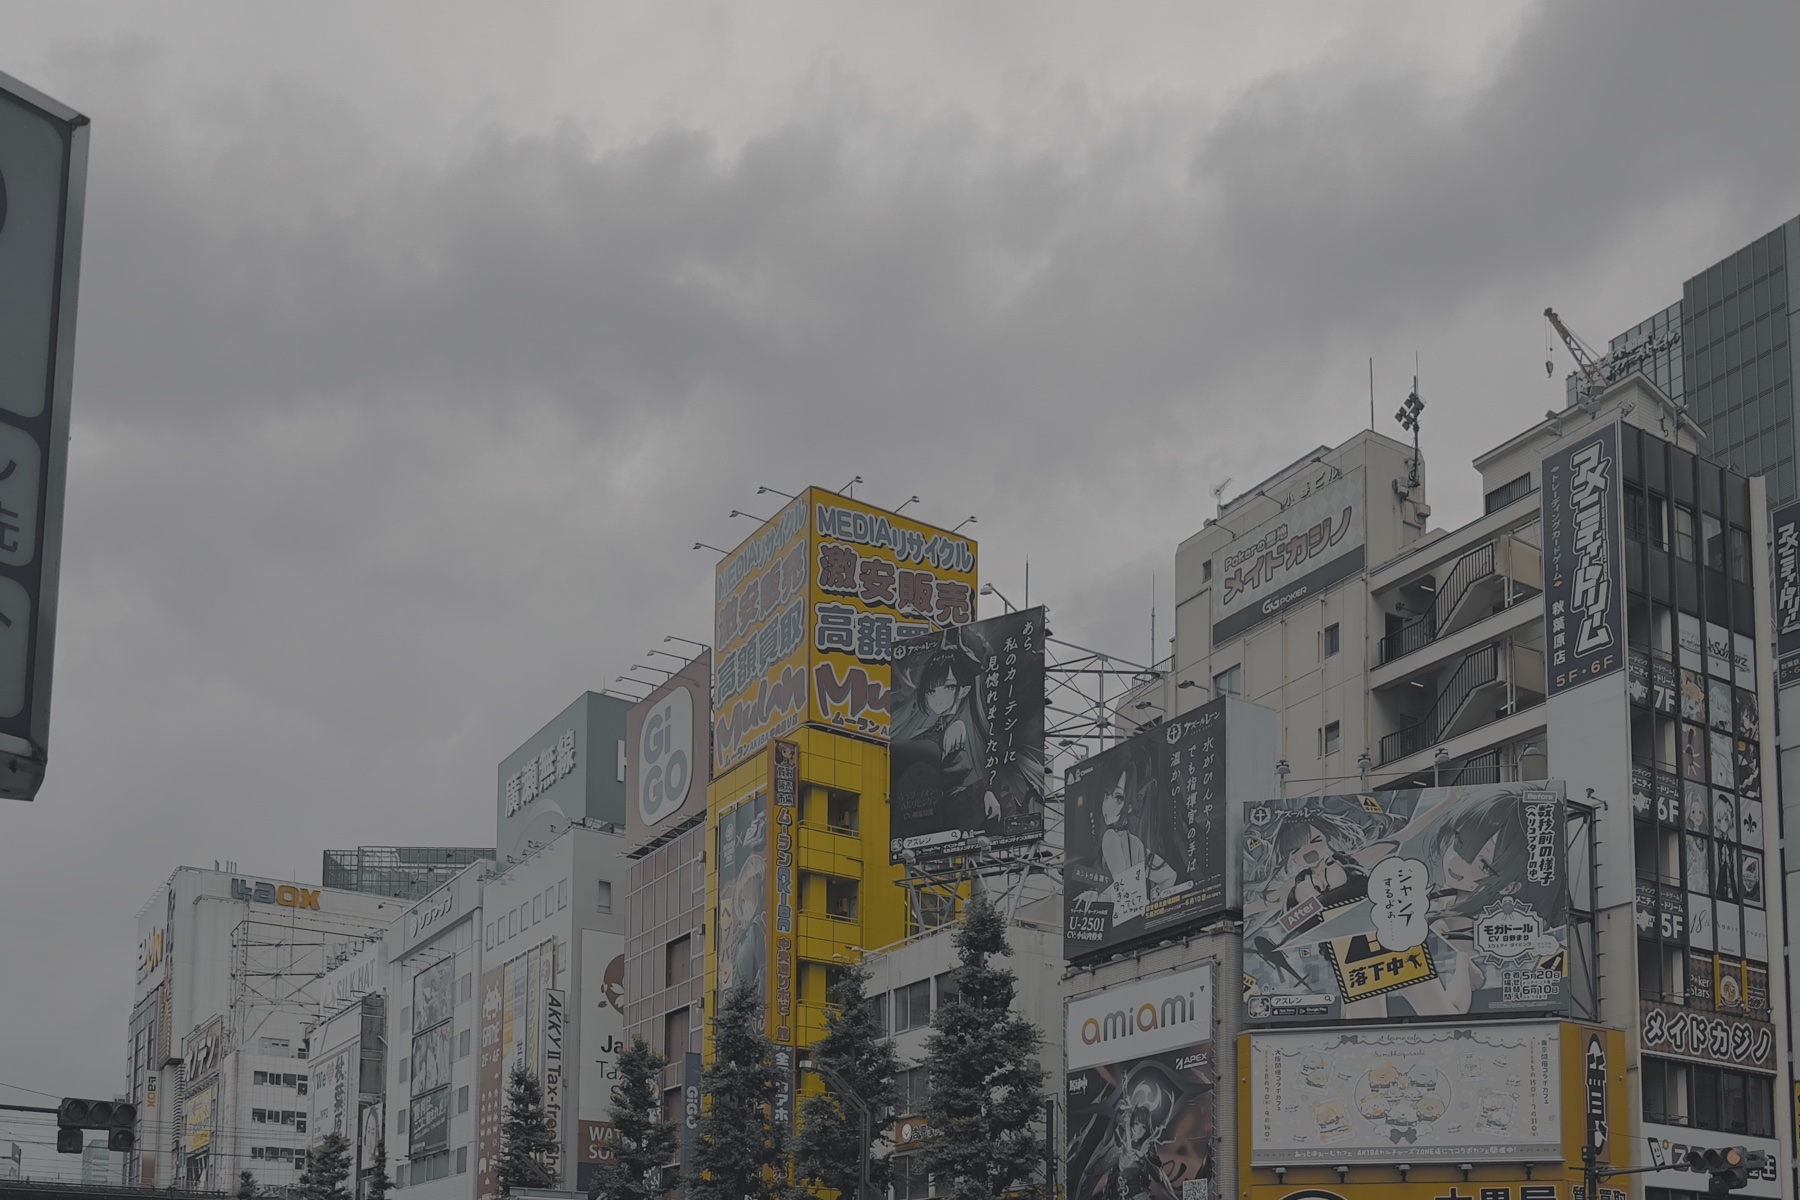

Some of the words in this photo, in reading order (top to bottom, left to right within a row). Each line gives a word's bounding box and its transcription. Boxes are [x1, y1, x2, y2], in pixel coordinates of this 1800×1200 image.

[816, 503, 974, 572] MEDIAリサイクル
[1224, 523, 1289, 572] Pokerの聖地
[1551, 474, 1562, 582] トレーディングカードゲーム
[1223, 506, 1353, 606] メイドカジノ
[717, 540, 806, 652] 激安販売
[817, 543, 971, 626] 激安販売
[717, 597, 804, 710] 高額買取
[1552, 599, 1565, 666] 秋葉原店
[814, 662, 891, 718] Mu
[1003, 637, 1018, 764] 私のカーテシーに
[1654, 685, 1675, 711] 7F
[716, 666, 806, 769] Mulan
[984, 655, 1000, 786] 見惚れましたか？
[1183, 711, 1220, 737] アズールレーン
[505, 728, 576, 818] 廣瀬無線
[1186, 744, 1198, 872] でも指揮官の手は
[1275, 808, 1324, 822] アズールレーン
[1657, 797, 1679, 822] 6F
[907, 837, 931, 847] アズレン
[1538, 804, 1554, 885] 数秒前の様子
[420, 895, 452, 929] ソフマップ
[1288, 901, 1315, 926] After
[1398, 869, 1414, 926] ジャンプ
[1069, 917, 1105, 931] U-2501
[1484, 924, 1533, 935] モガドール
[1662, 913, 1683, 938] 5F
[1349, 957, 1404, 988] 落下中
[1522, 971, 1560, 980] 5月20日
[1522, 985, 1558, 994] 6月10日
[1691, 984, 1710, 999] Stars
[548, 993, 562, 1049] AKKY
[1081, 992, 1194, 1045] amiami
[1275, 997, 1302, 1005] アズレン
[1184, 1053, 1207, 1064] APEX
[1643, 1009, 1771, 1064] メイドカジノ
[547, 1144, 559, 1175] Sho
